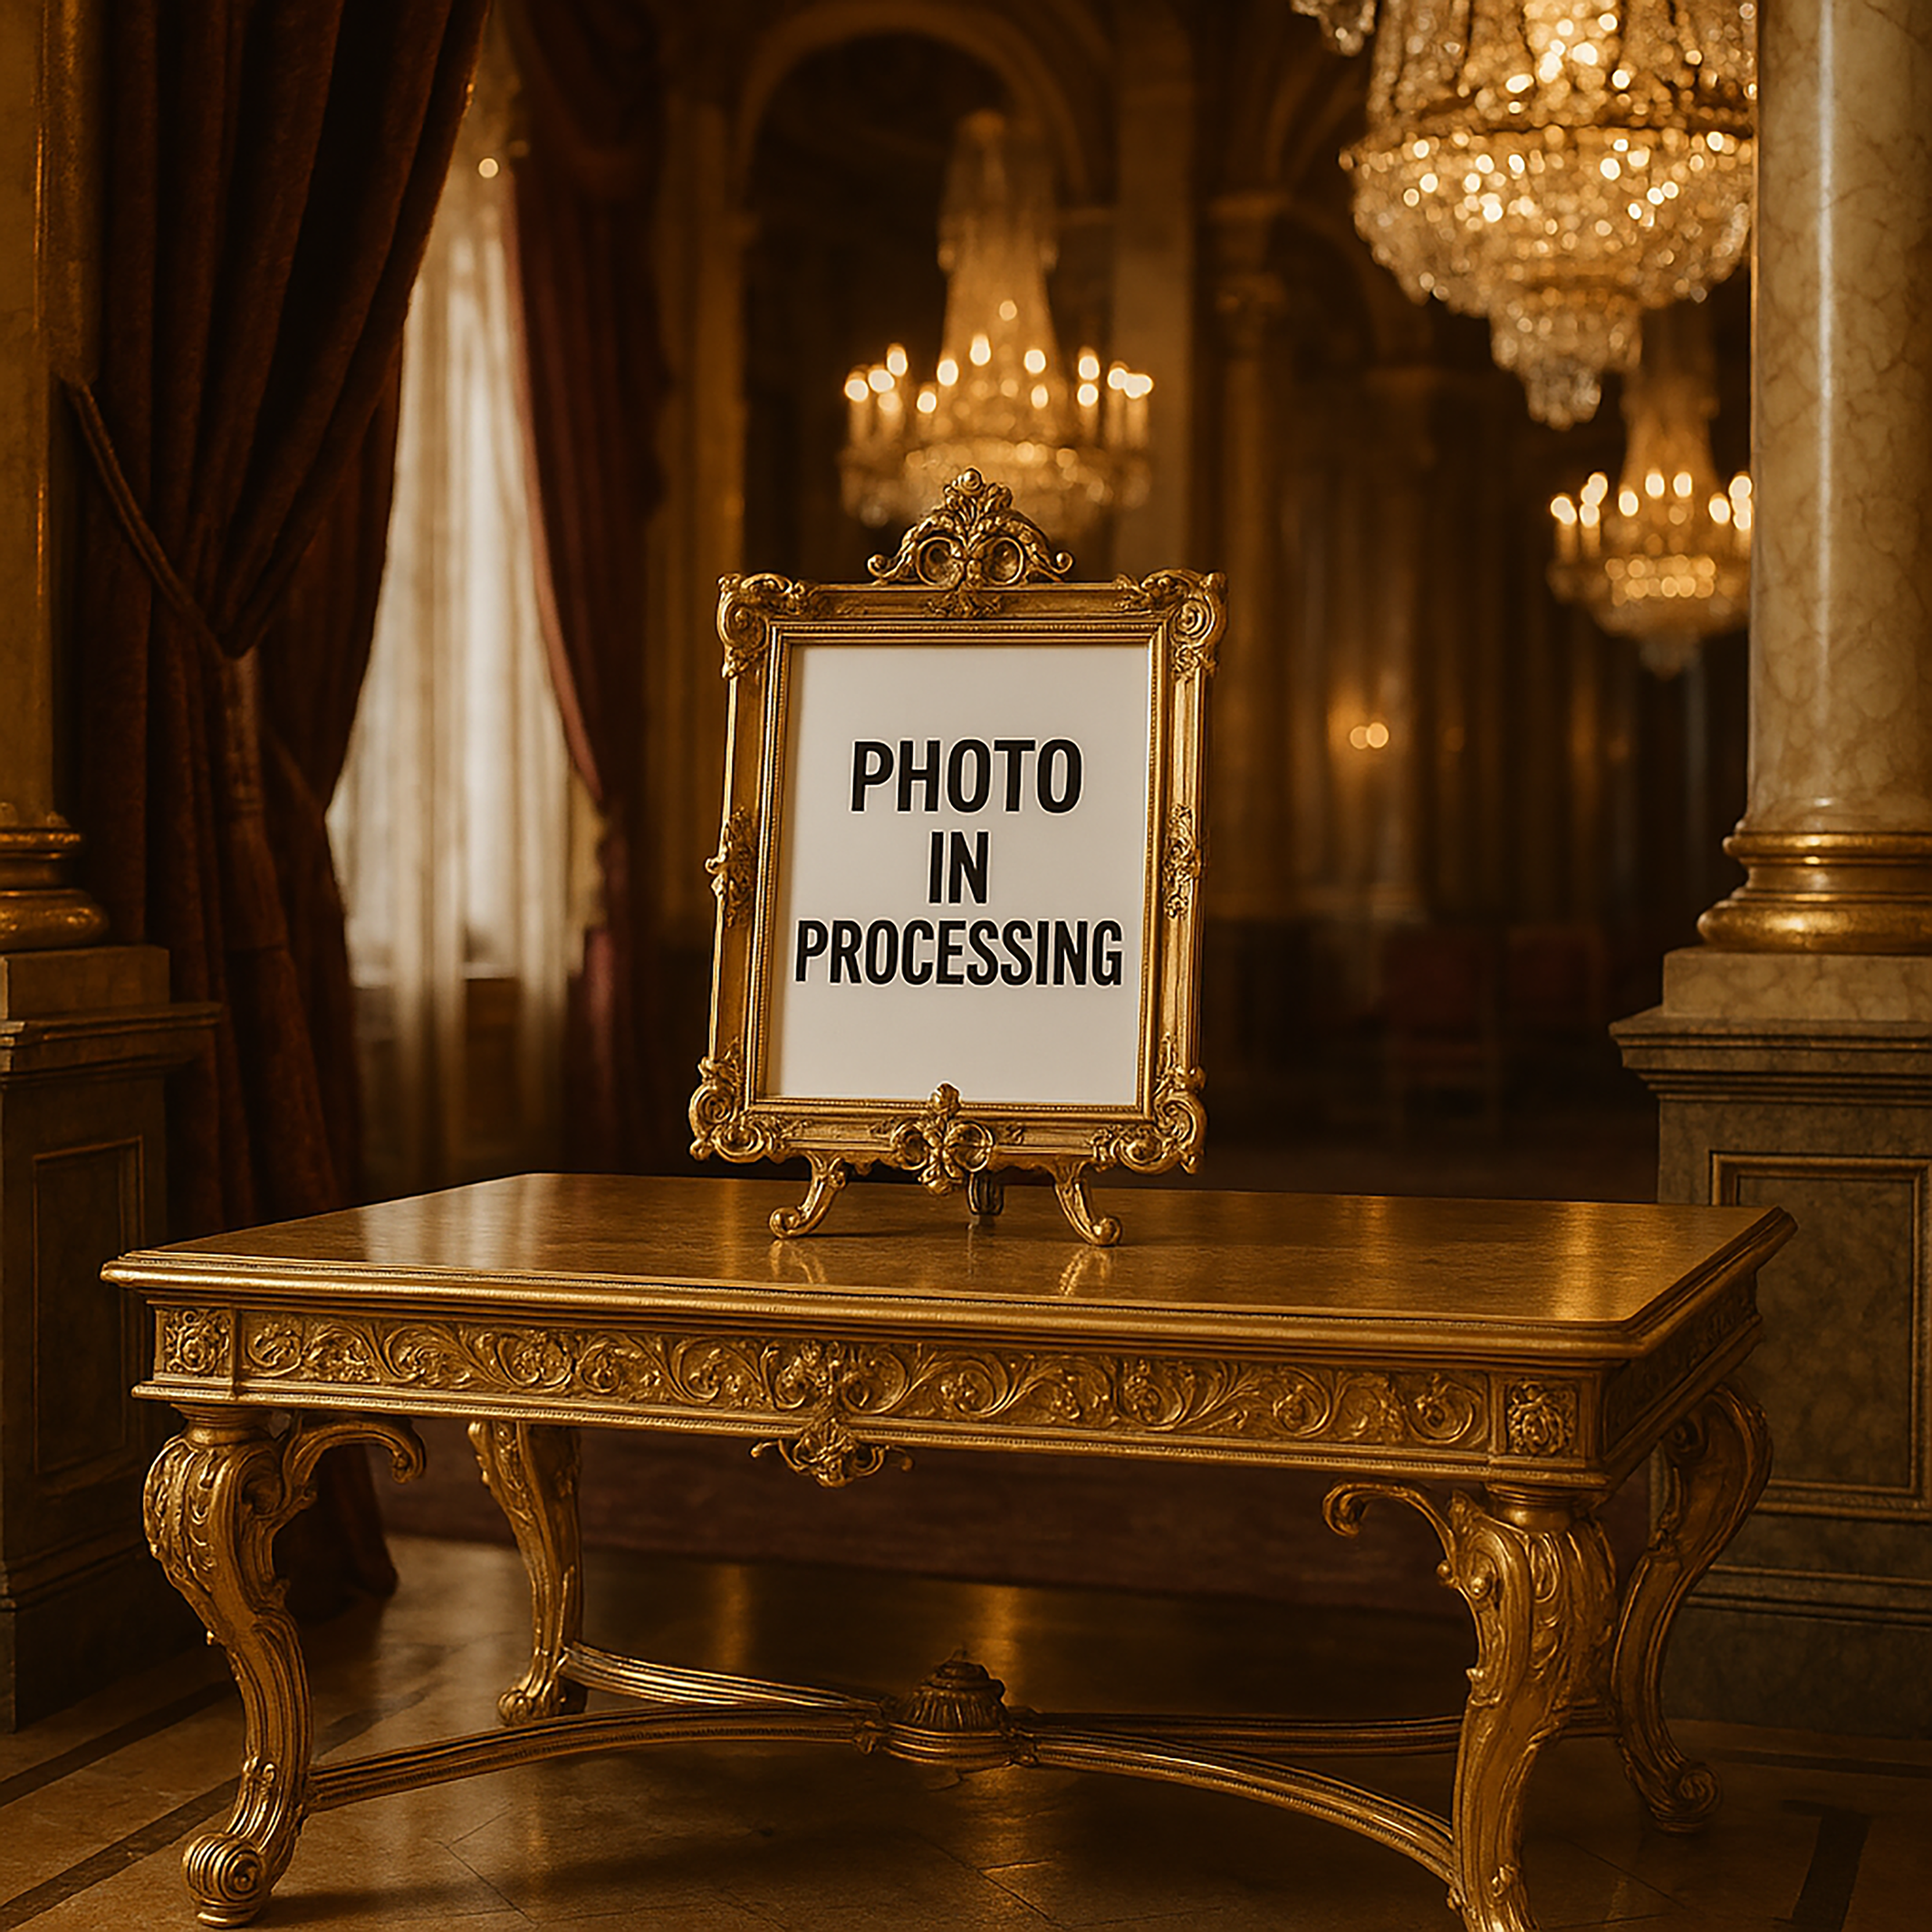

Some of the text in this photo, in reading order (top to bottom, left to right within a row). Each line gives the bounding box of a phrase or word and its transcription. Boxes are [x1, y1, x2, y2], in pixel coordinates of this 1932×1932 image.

[851, 738, 1082, 813] PHOTO
[928, 831, 989, 904] IN
[795, 919, 1123, 986] PROCESSING
